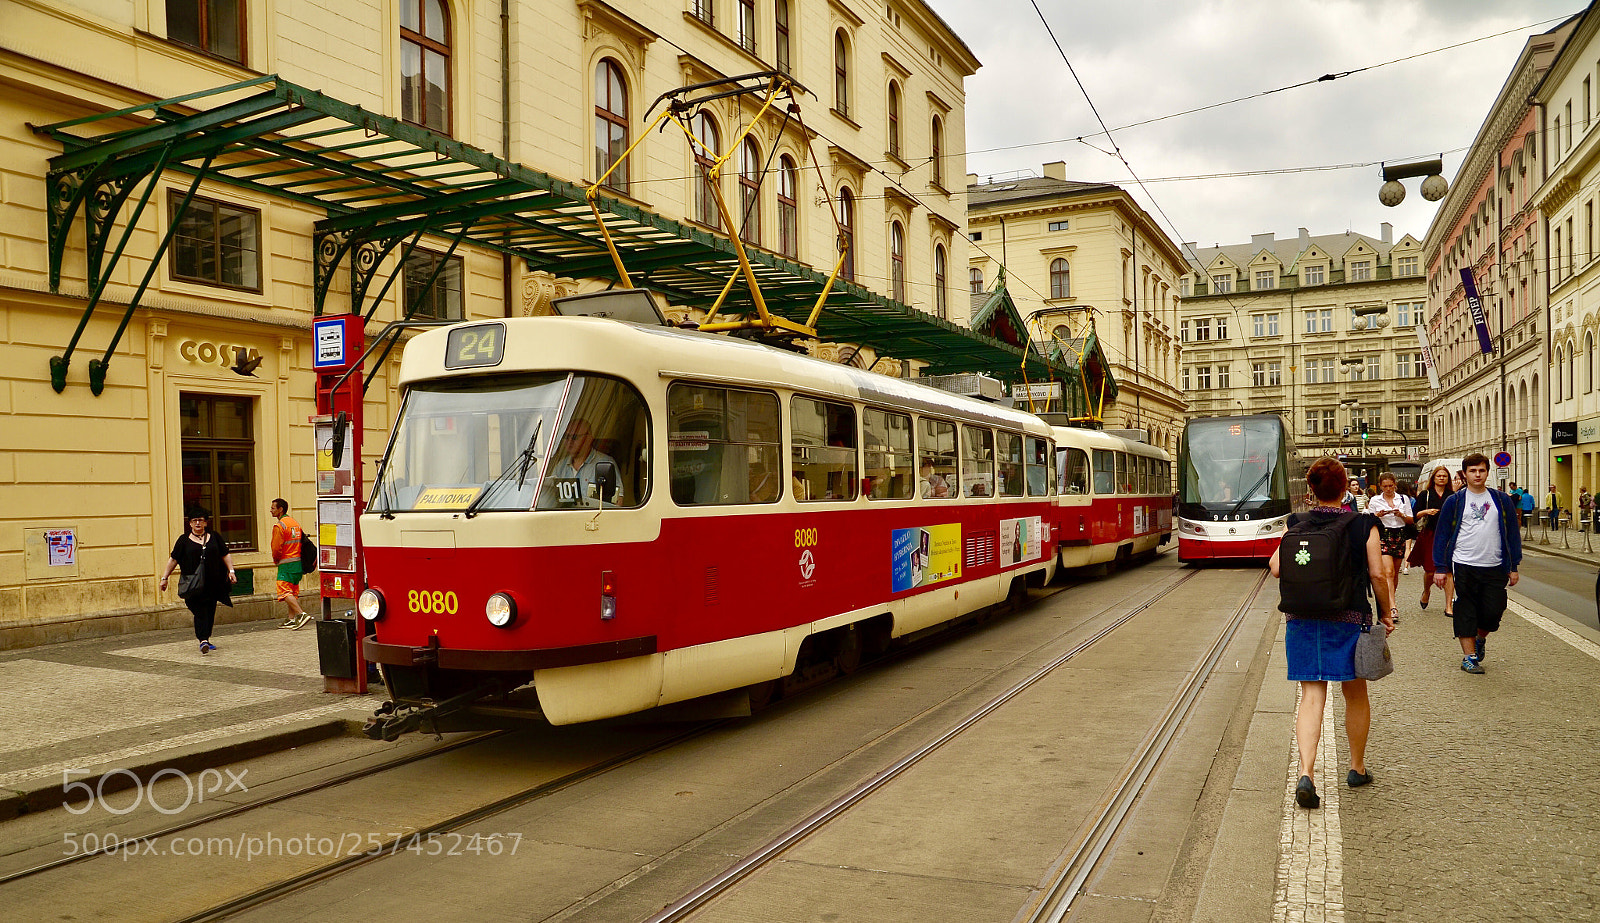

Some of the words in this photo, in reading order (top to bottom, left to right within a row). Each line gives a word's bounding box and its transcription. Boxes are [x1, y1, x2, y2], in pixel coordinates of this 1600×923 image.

[1469, 296, 1484, 325] FINEP
[180, 340, 262, 368] COSTA
[459, 328, 496, 361] 24
[1390, 445, 1427, 455] ARO
[419, 494, 473, 504] PALMOVKA
[556, 481, 580, 499] 101
[1213, 513, 1250, 522] 9400
[794, 527, 818, 548] 8080
[408, 589, 459, 615] 8080
